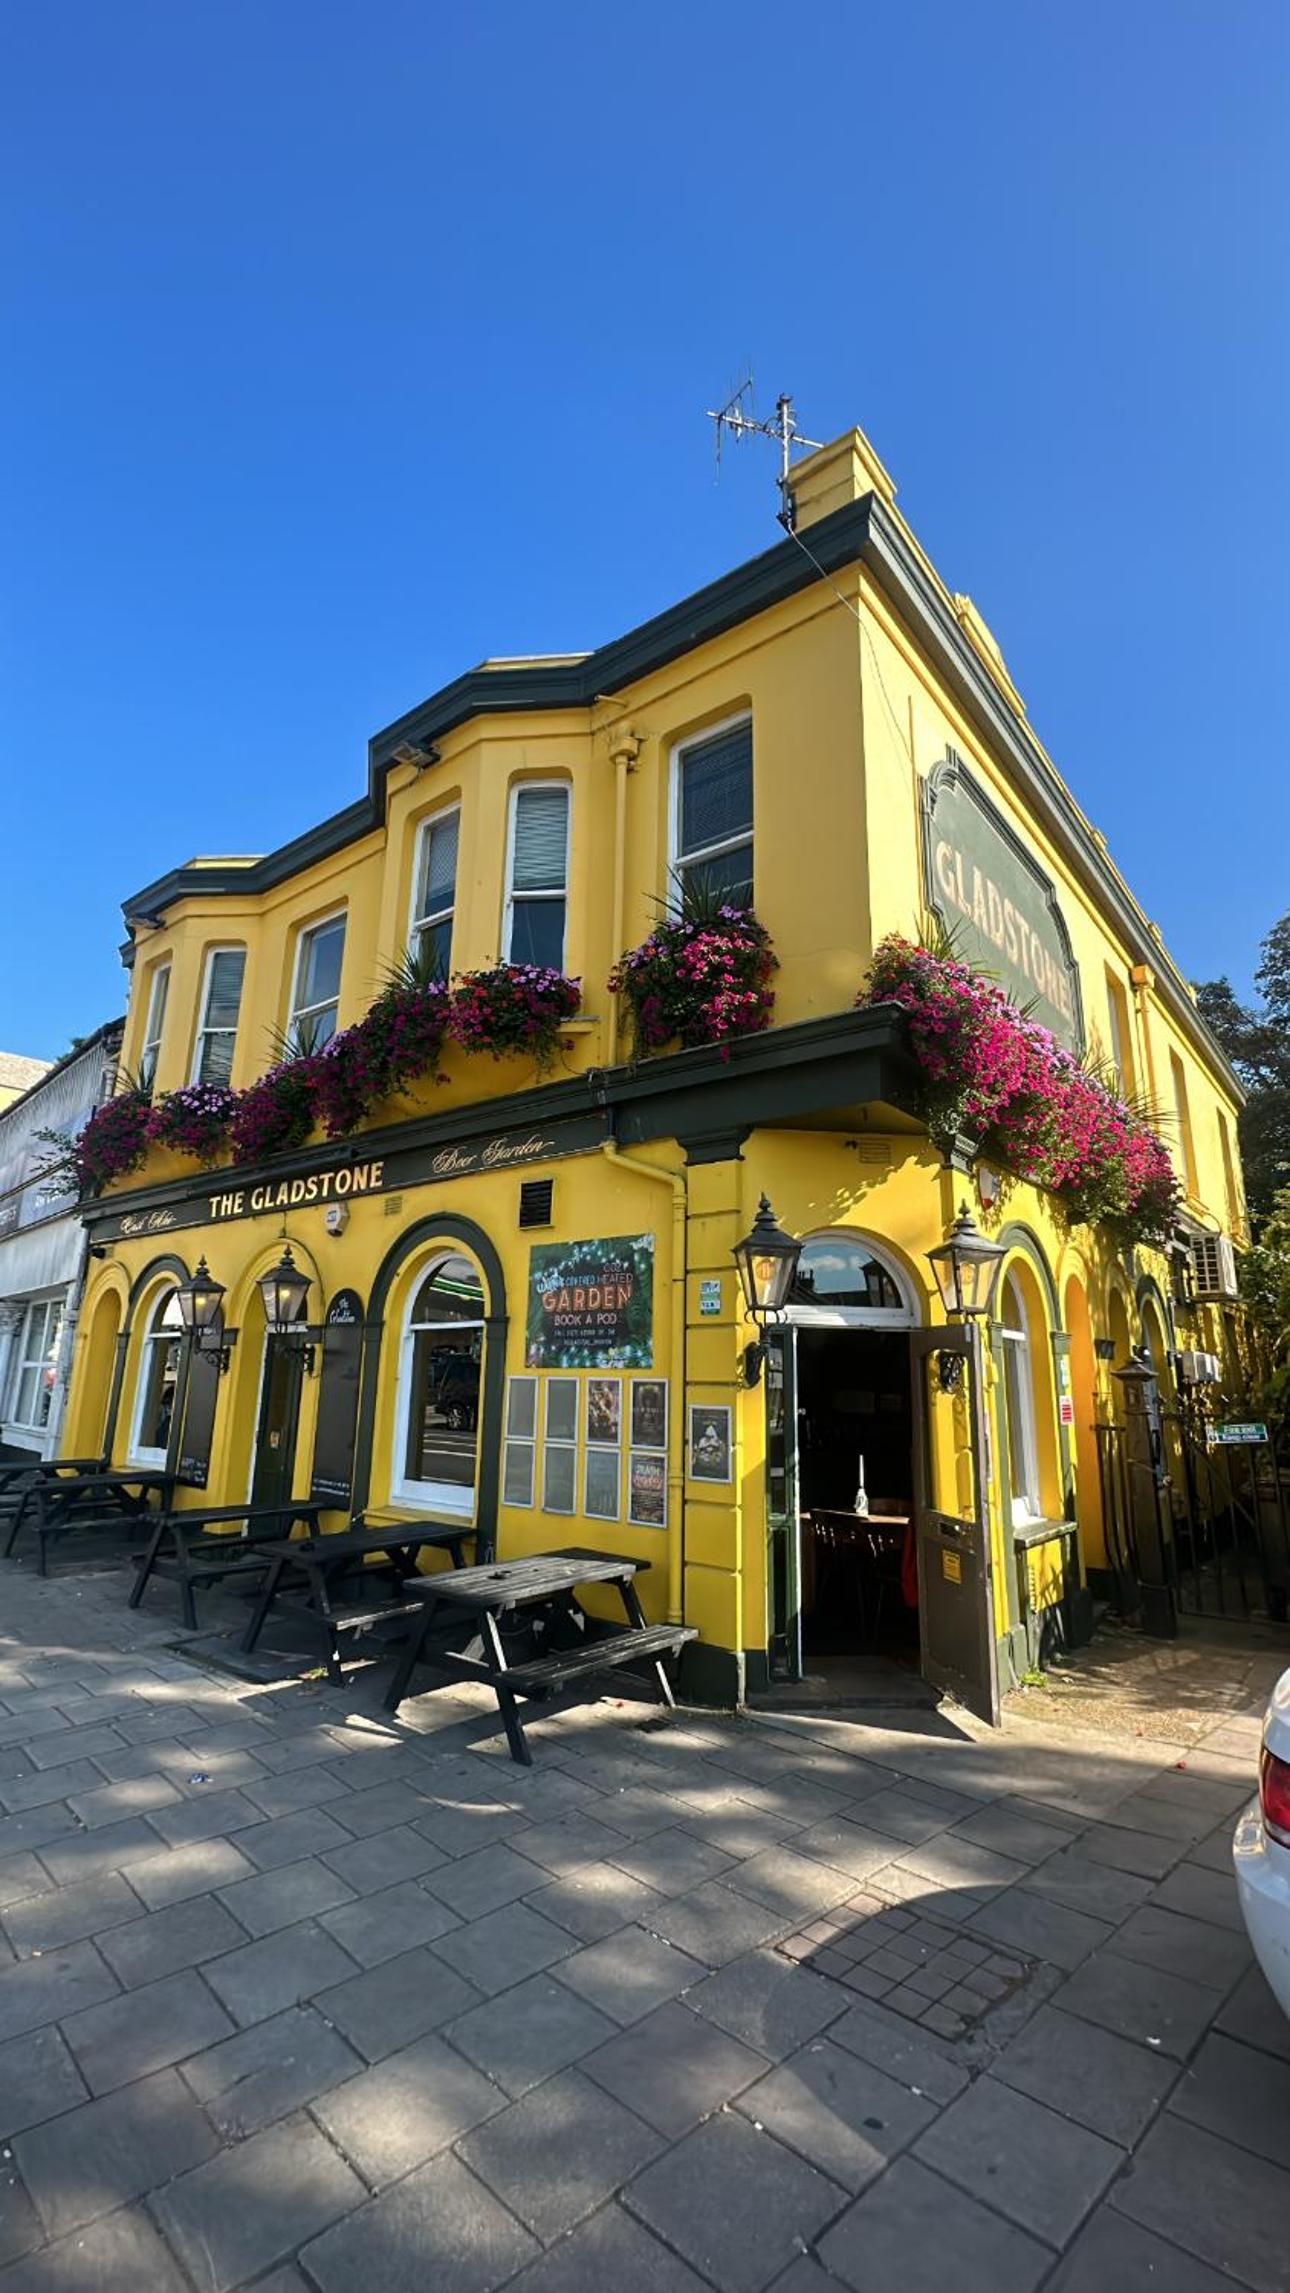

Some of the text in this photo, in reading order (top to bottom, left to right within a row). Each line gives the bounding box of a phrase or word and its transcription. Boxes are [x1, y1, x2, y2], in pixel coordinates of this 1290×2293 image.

[935, 840, 1071, 1019] GLADSTONE
[432, 1133, 556, 1174] Beer Garden
[209, 1161, 385, 1218] THE GLADSTONE
[542, 1284, 633, 1310] GARDEN
[554, 1312, 617, 1326] BOOK A POD
